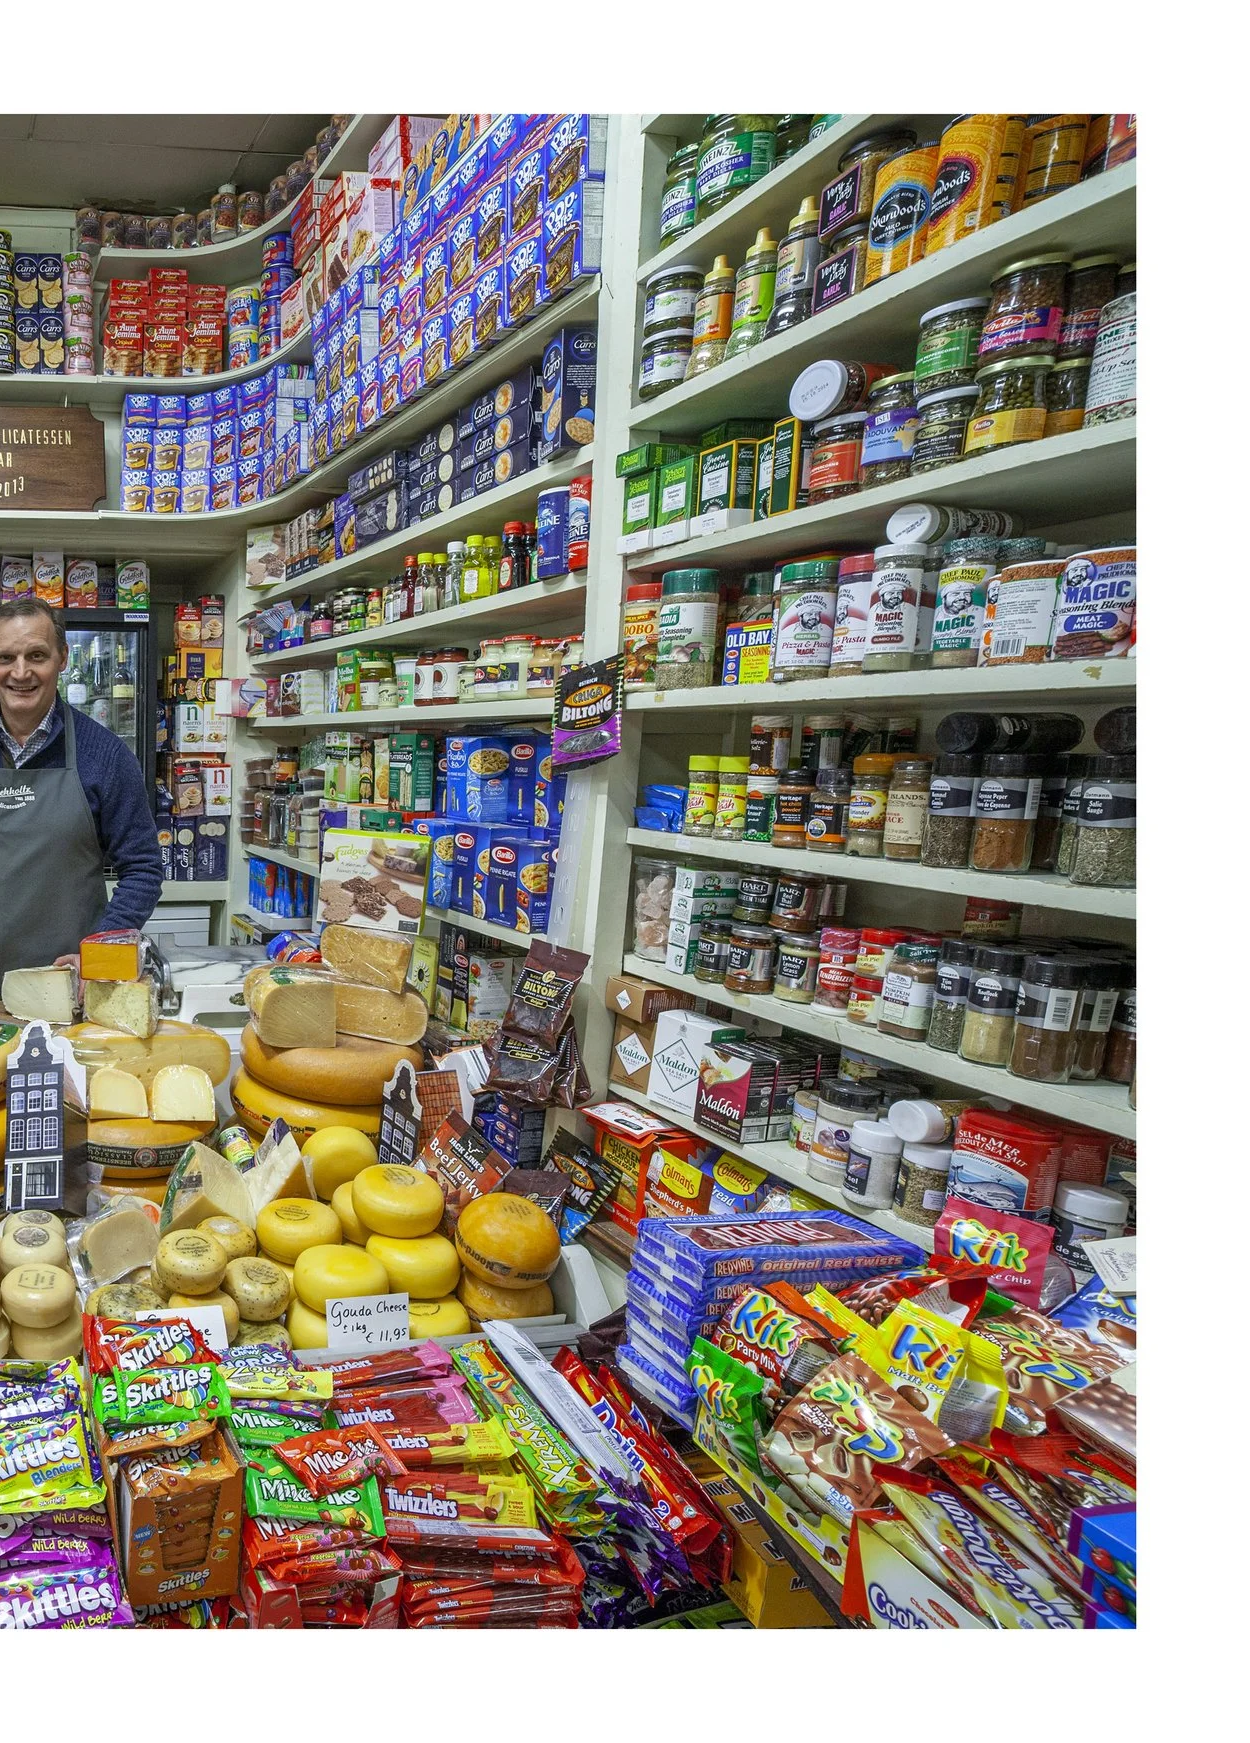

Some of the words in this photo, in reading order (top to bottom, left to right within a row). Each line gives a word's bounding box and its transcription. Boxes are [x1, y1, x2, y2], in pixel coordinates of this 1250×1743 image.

[703, 143, 730, 169] HEINZ
[714, 155, 744, 171] KOSHER
[829, 201, 848, 221] GARLIC
[871, 200, 927, 230] Sharwood's
[823, 282, 841, 299] GARLIC
[112, 331, 140, 339] Jemima
[119, 324, 137, 332] Aunt
[1066, 581, 1130, 602] MAGIC
[1101, 601, 1135, 611] Blends
[875, 612, 903, 622] MAGIC
[935, 615, 975, 632] MAGIC
[1073, 621, 1103, 629] MAGIC
[727, 631, 747, 647] OLD
[749, 630, 770, 645] BAY
[781, 641, 802, 649] Pizza
[812, 641, 831, 649] Pasta
[742, 646, 770, 658] SEASONING
[562, 696, 612, 722] BILTONG
[514, 747, 532, 757] Barilla
[495, 850, 515, 862] Barilla
[782, 961, 799, 969] Lemon
[782, 966, 798, 974] Grass
[523, 981, 558, 997] BILTONG
[617, 1045, 648, 1063] Maldon
[660, 1055, 698, 1077] Maldon
[700, 1090, 740, 1120] Maldon
[959, 1130, 972, 1138] SEL
[989, 1138, 1020, 1155] MER
[449, 1138, 465, 1154] JACK
[463, 1151, 484, 1173] LINK'S
[1005, 1155, 1027, 1167] SALT
[430, 1138, 456, 1169] Beef
[450, 1164, 481, 1199] Jerky
[717, 1162, 752, 1191] Colman's
[662, 1163, 695, 1195] Colman's
[650, 1183, 685, 1211] Shepherd's
[761, 1261, 820, 1270] Original
[824, 1260, 850, 1268] Red
[1005, 1274, 1031, 1285] Chip
[331, 1303, 373, 1327] Gouda
[376, 1301, 407, 1316] Cheese
[379, 1328, 407, 1342] 11,95
[120, 1323, 193, 1371] Skittles
[736, 1339, 761, 1361] Party
[760, 1354, 776, 1373] Mix
[887, 1364, 920, 1386] Malt
[126, 1367, 211, 1408] Skittles
[337, 1408, 395, 1427] Twizzlers
[590, 1400, 645, 1475] Daim
[304, 1450, 348, 1476] Mike
[31, 1462, 82, 1486] Blenders
[385, 1488, 457, 1519] Twizzlers
